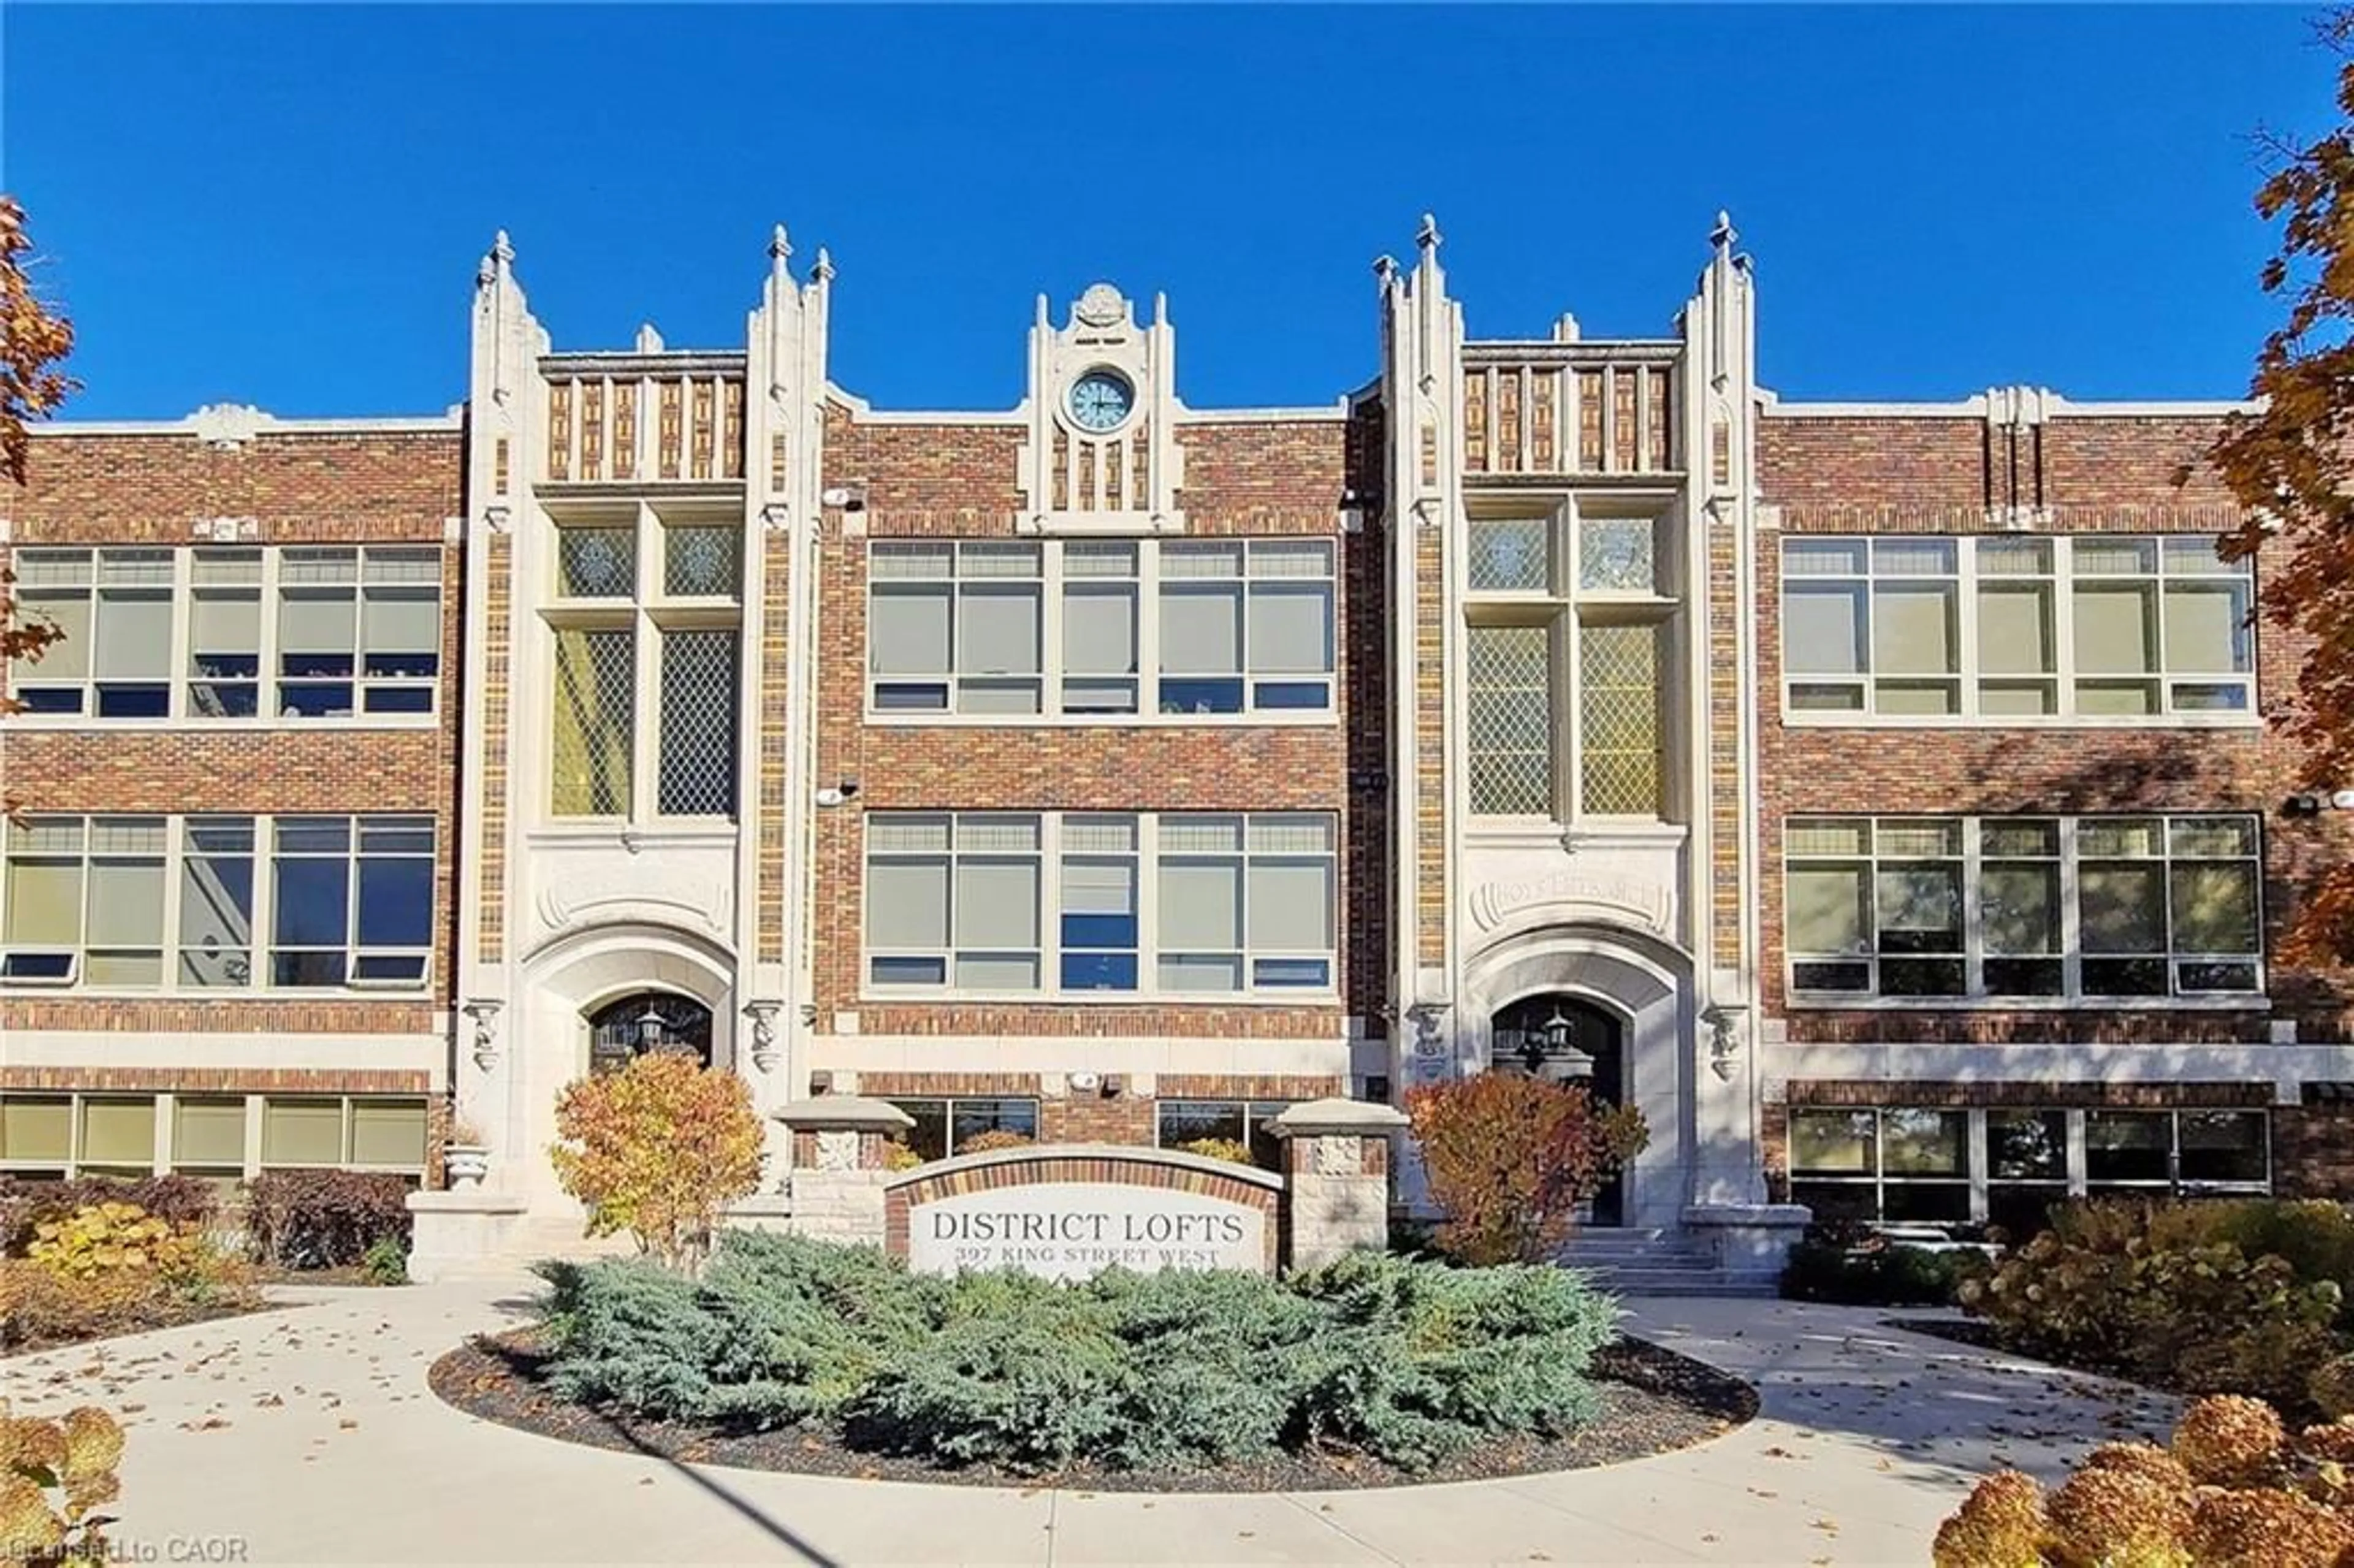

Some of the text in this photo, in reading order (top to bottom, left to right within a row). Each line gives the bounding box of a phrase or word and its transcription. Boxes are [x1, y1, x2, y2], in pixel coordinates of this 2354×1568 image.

[934, 1213, 1244, 1242] DISTRICT LOFTS
[955, 1247, 1220, 1264] 397 KING STREET WEST
